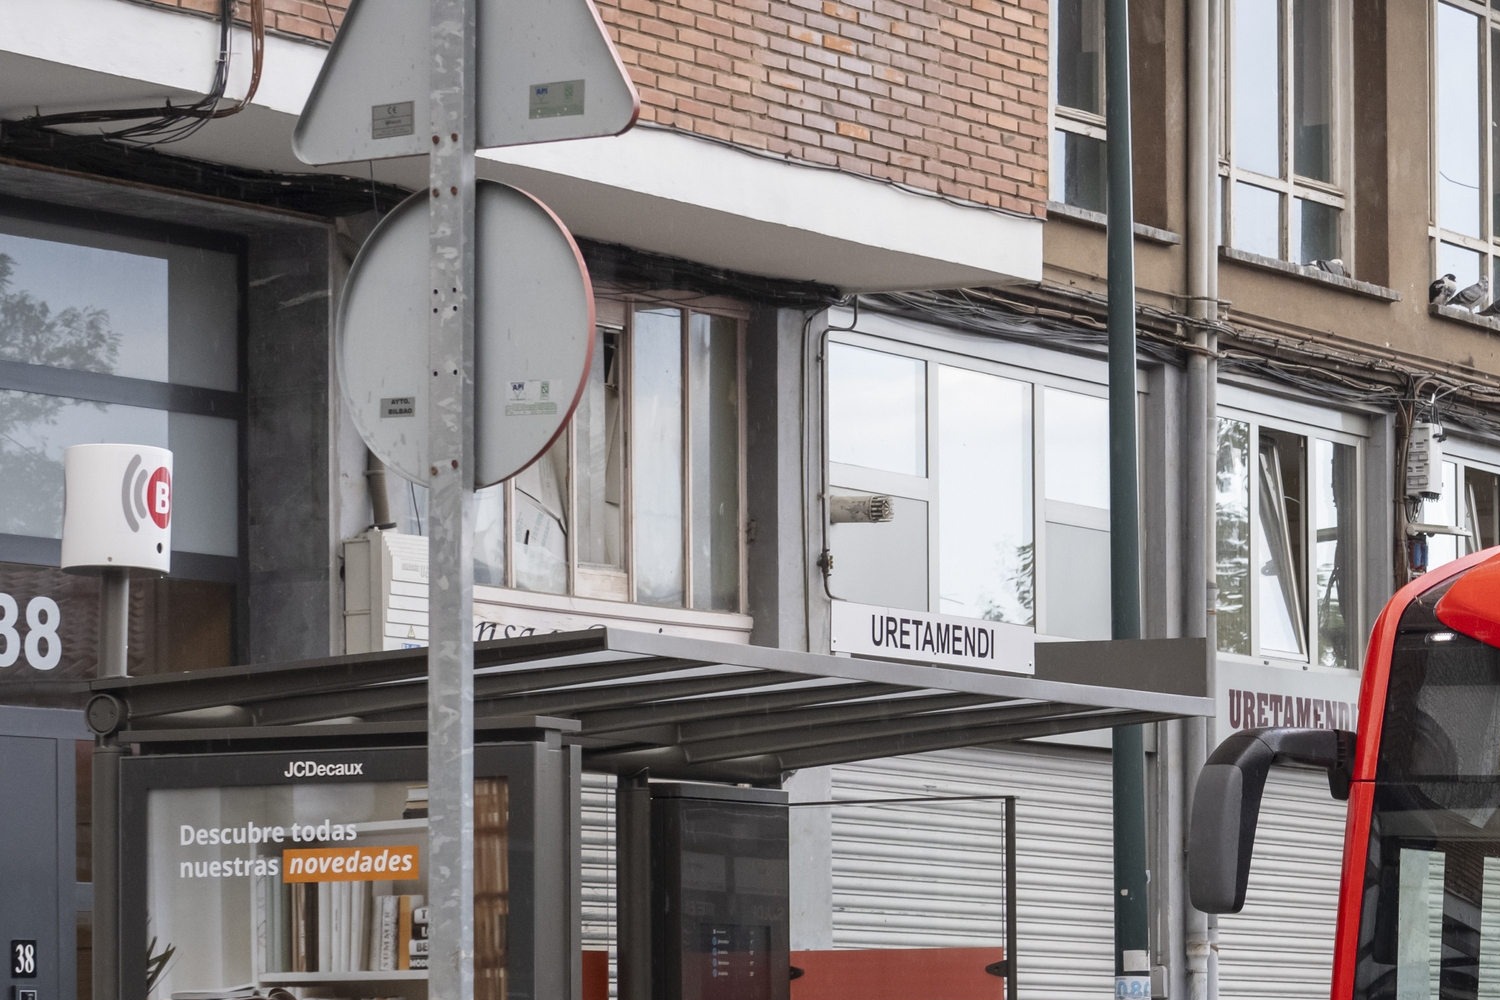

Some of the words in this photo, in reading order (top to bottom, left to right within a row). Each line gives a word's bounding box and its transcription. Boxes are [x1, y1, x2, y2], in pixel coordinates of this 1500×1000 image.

[535, 87, 548, 96] API
[155, 480, 170, 514] B
[871, 614, 995, 660] URETAMENDI
[1228, 689, 1358, 731] URETAMENDI
[284, 761, 364, 778] JCDecaux
[179, 822, 285, 846] Descubre
[290, 819, 358, 842] todas
[179, 856, 279, 878] nuestras
[289, 850, 413, 875] novedades
[15, 944, 35, 973] 38
